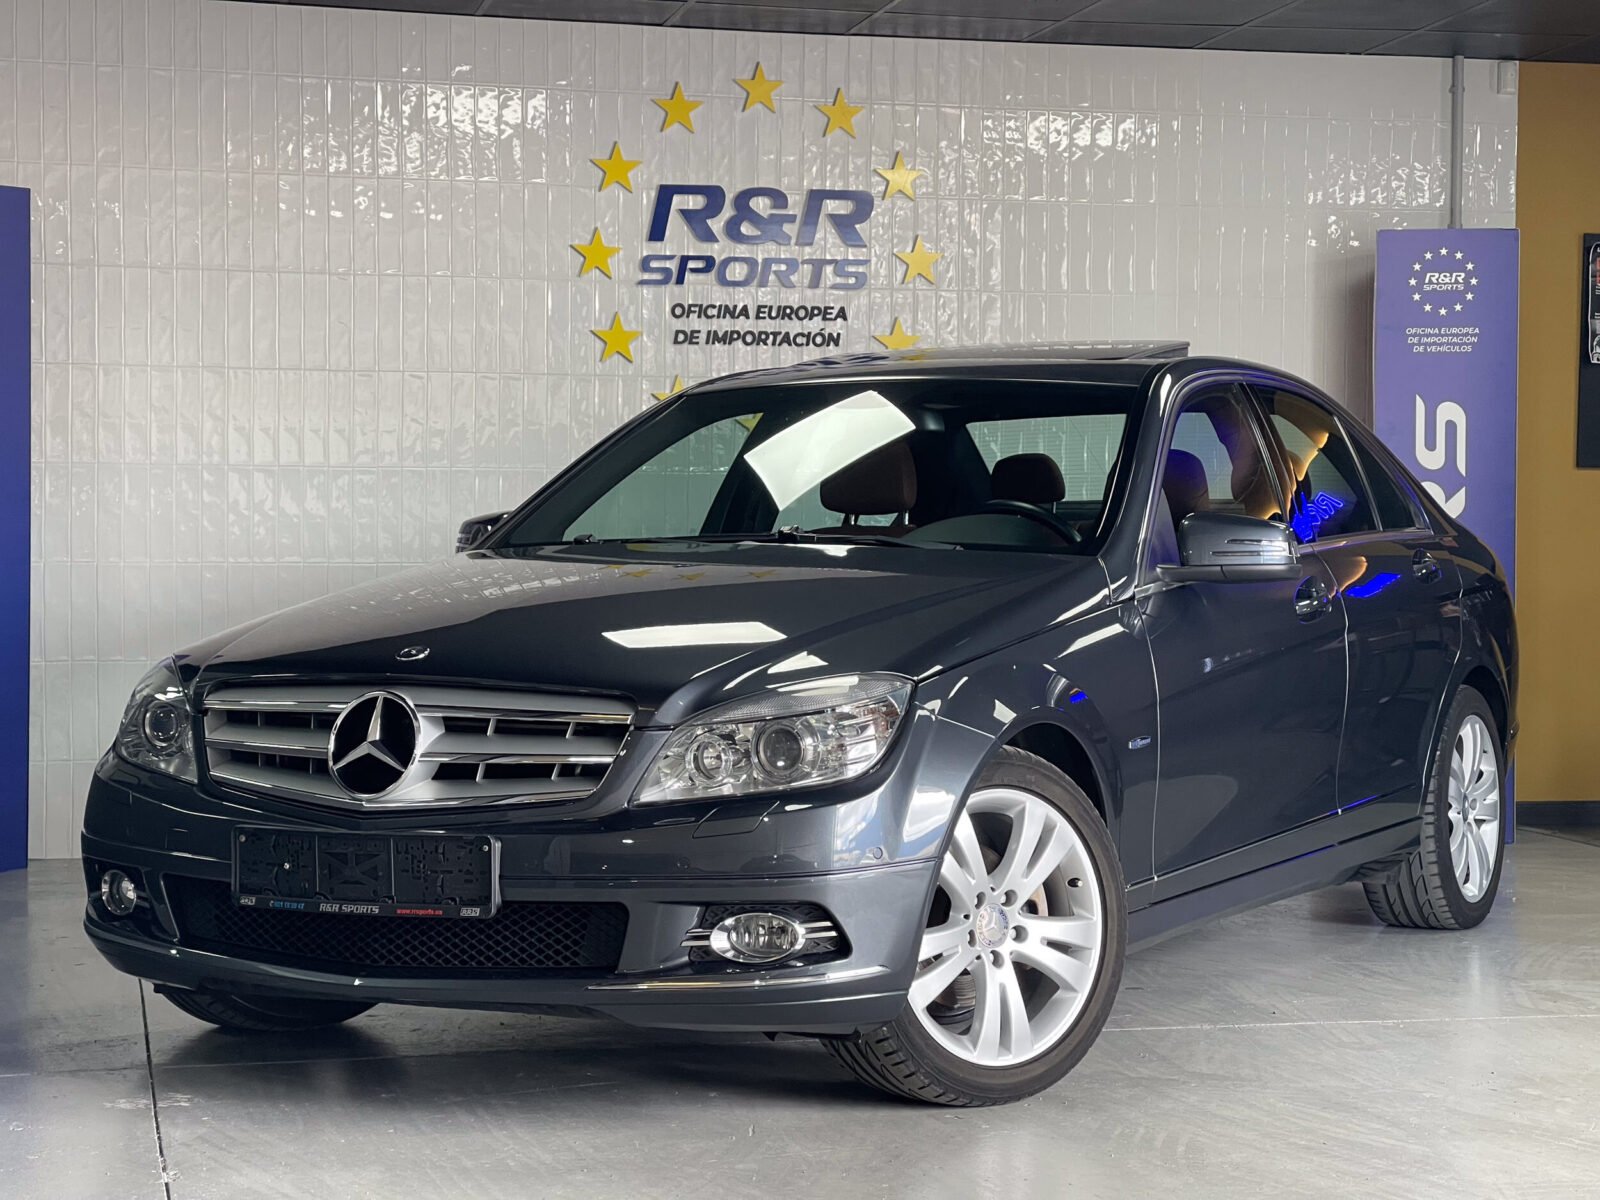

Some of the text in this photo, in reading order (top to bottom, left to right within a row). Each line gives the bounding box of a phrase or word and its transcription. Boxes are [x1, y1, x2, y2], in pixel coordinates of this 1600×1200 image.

[648, 184, 874, 247] R&R
[637, 255, 870, 289] SPORTS
[1425, 272, 1465, 283] R&R
[671, 303, 848, 322] OFICINA EUROPEA
[673, 328, 840, 347] DE IMPORTACIÓN
[1421, 335, 1478, 344] IMPORTACIÓN
[1426, 344, 1472, 352] VEHÍCULOS
[319, 903, 380, 914] R&R SPORTS
